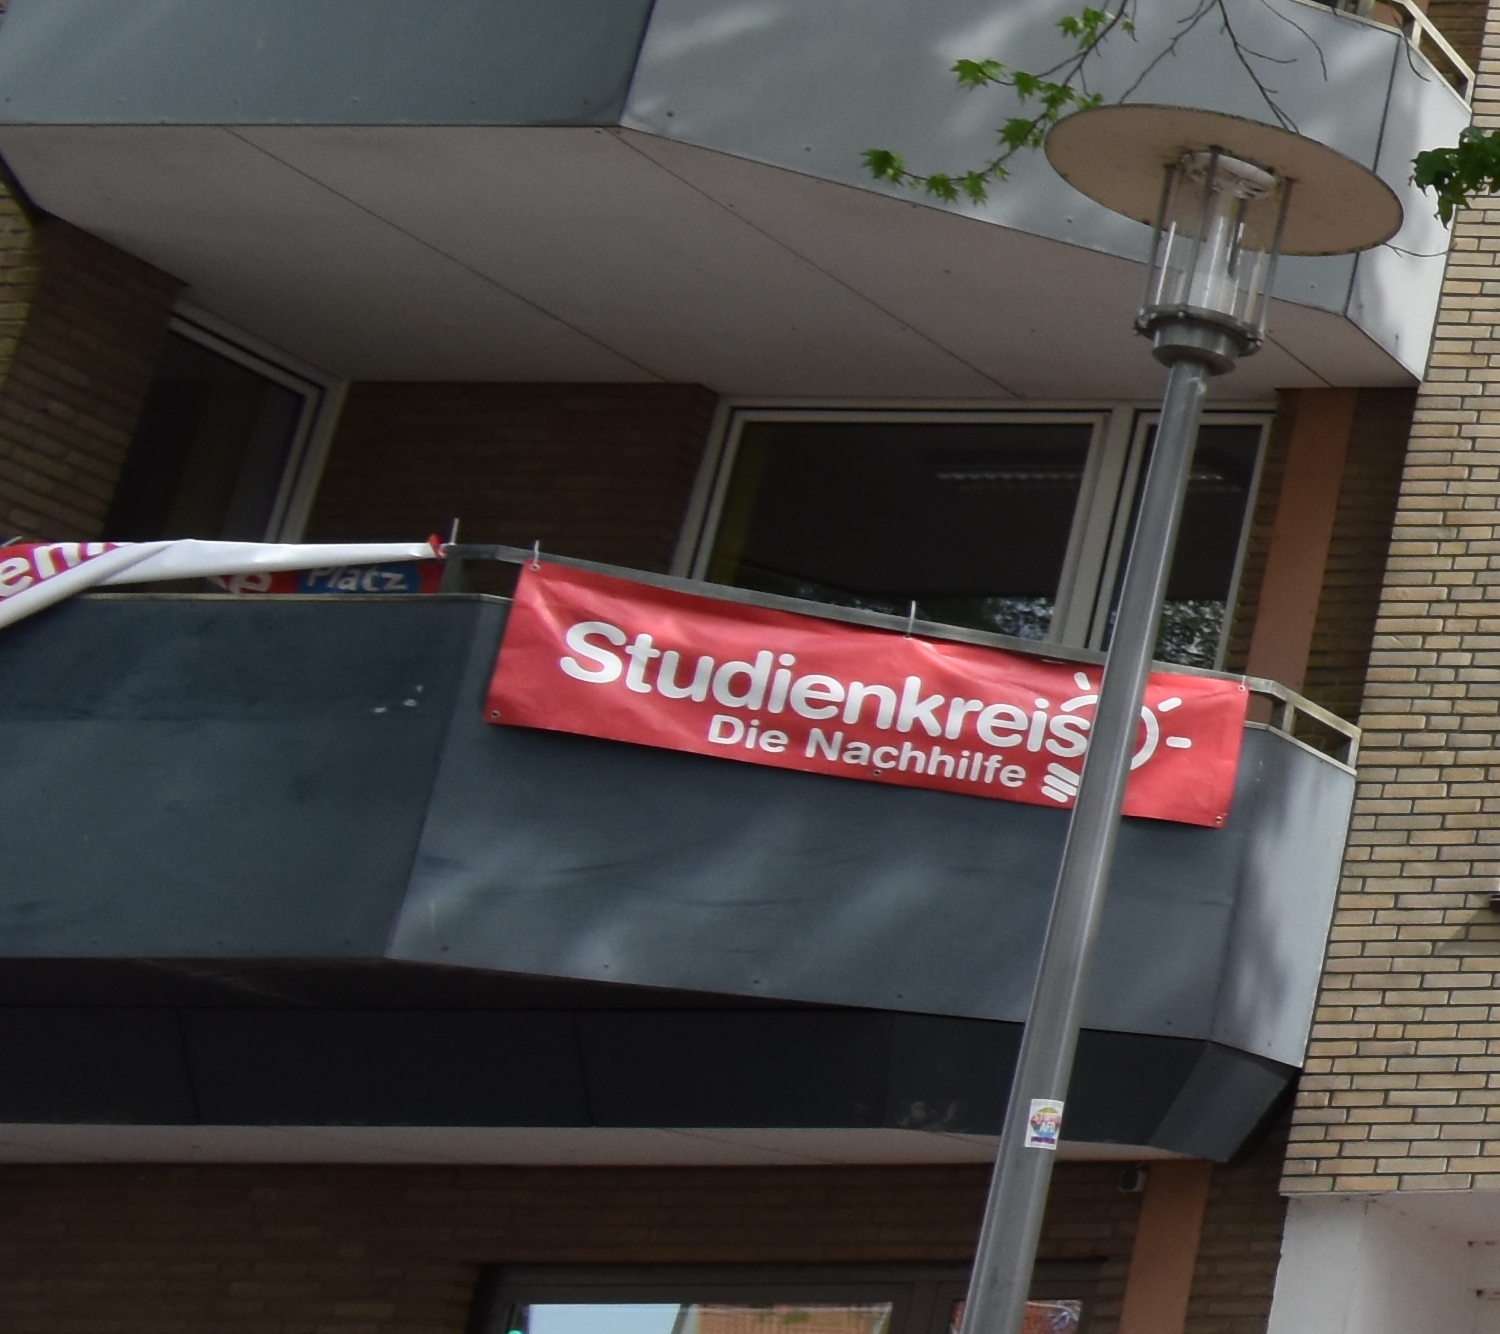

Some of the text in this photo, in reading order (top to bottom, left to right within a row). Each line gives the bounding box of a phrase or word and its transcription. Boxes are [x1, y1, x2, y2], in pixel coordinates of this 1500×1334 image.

[560, 621, 1091, 757] Studienkreis
[708, 713, 1027, 788] Die Nachhilfe
